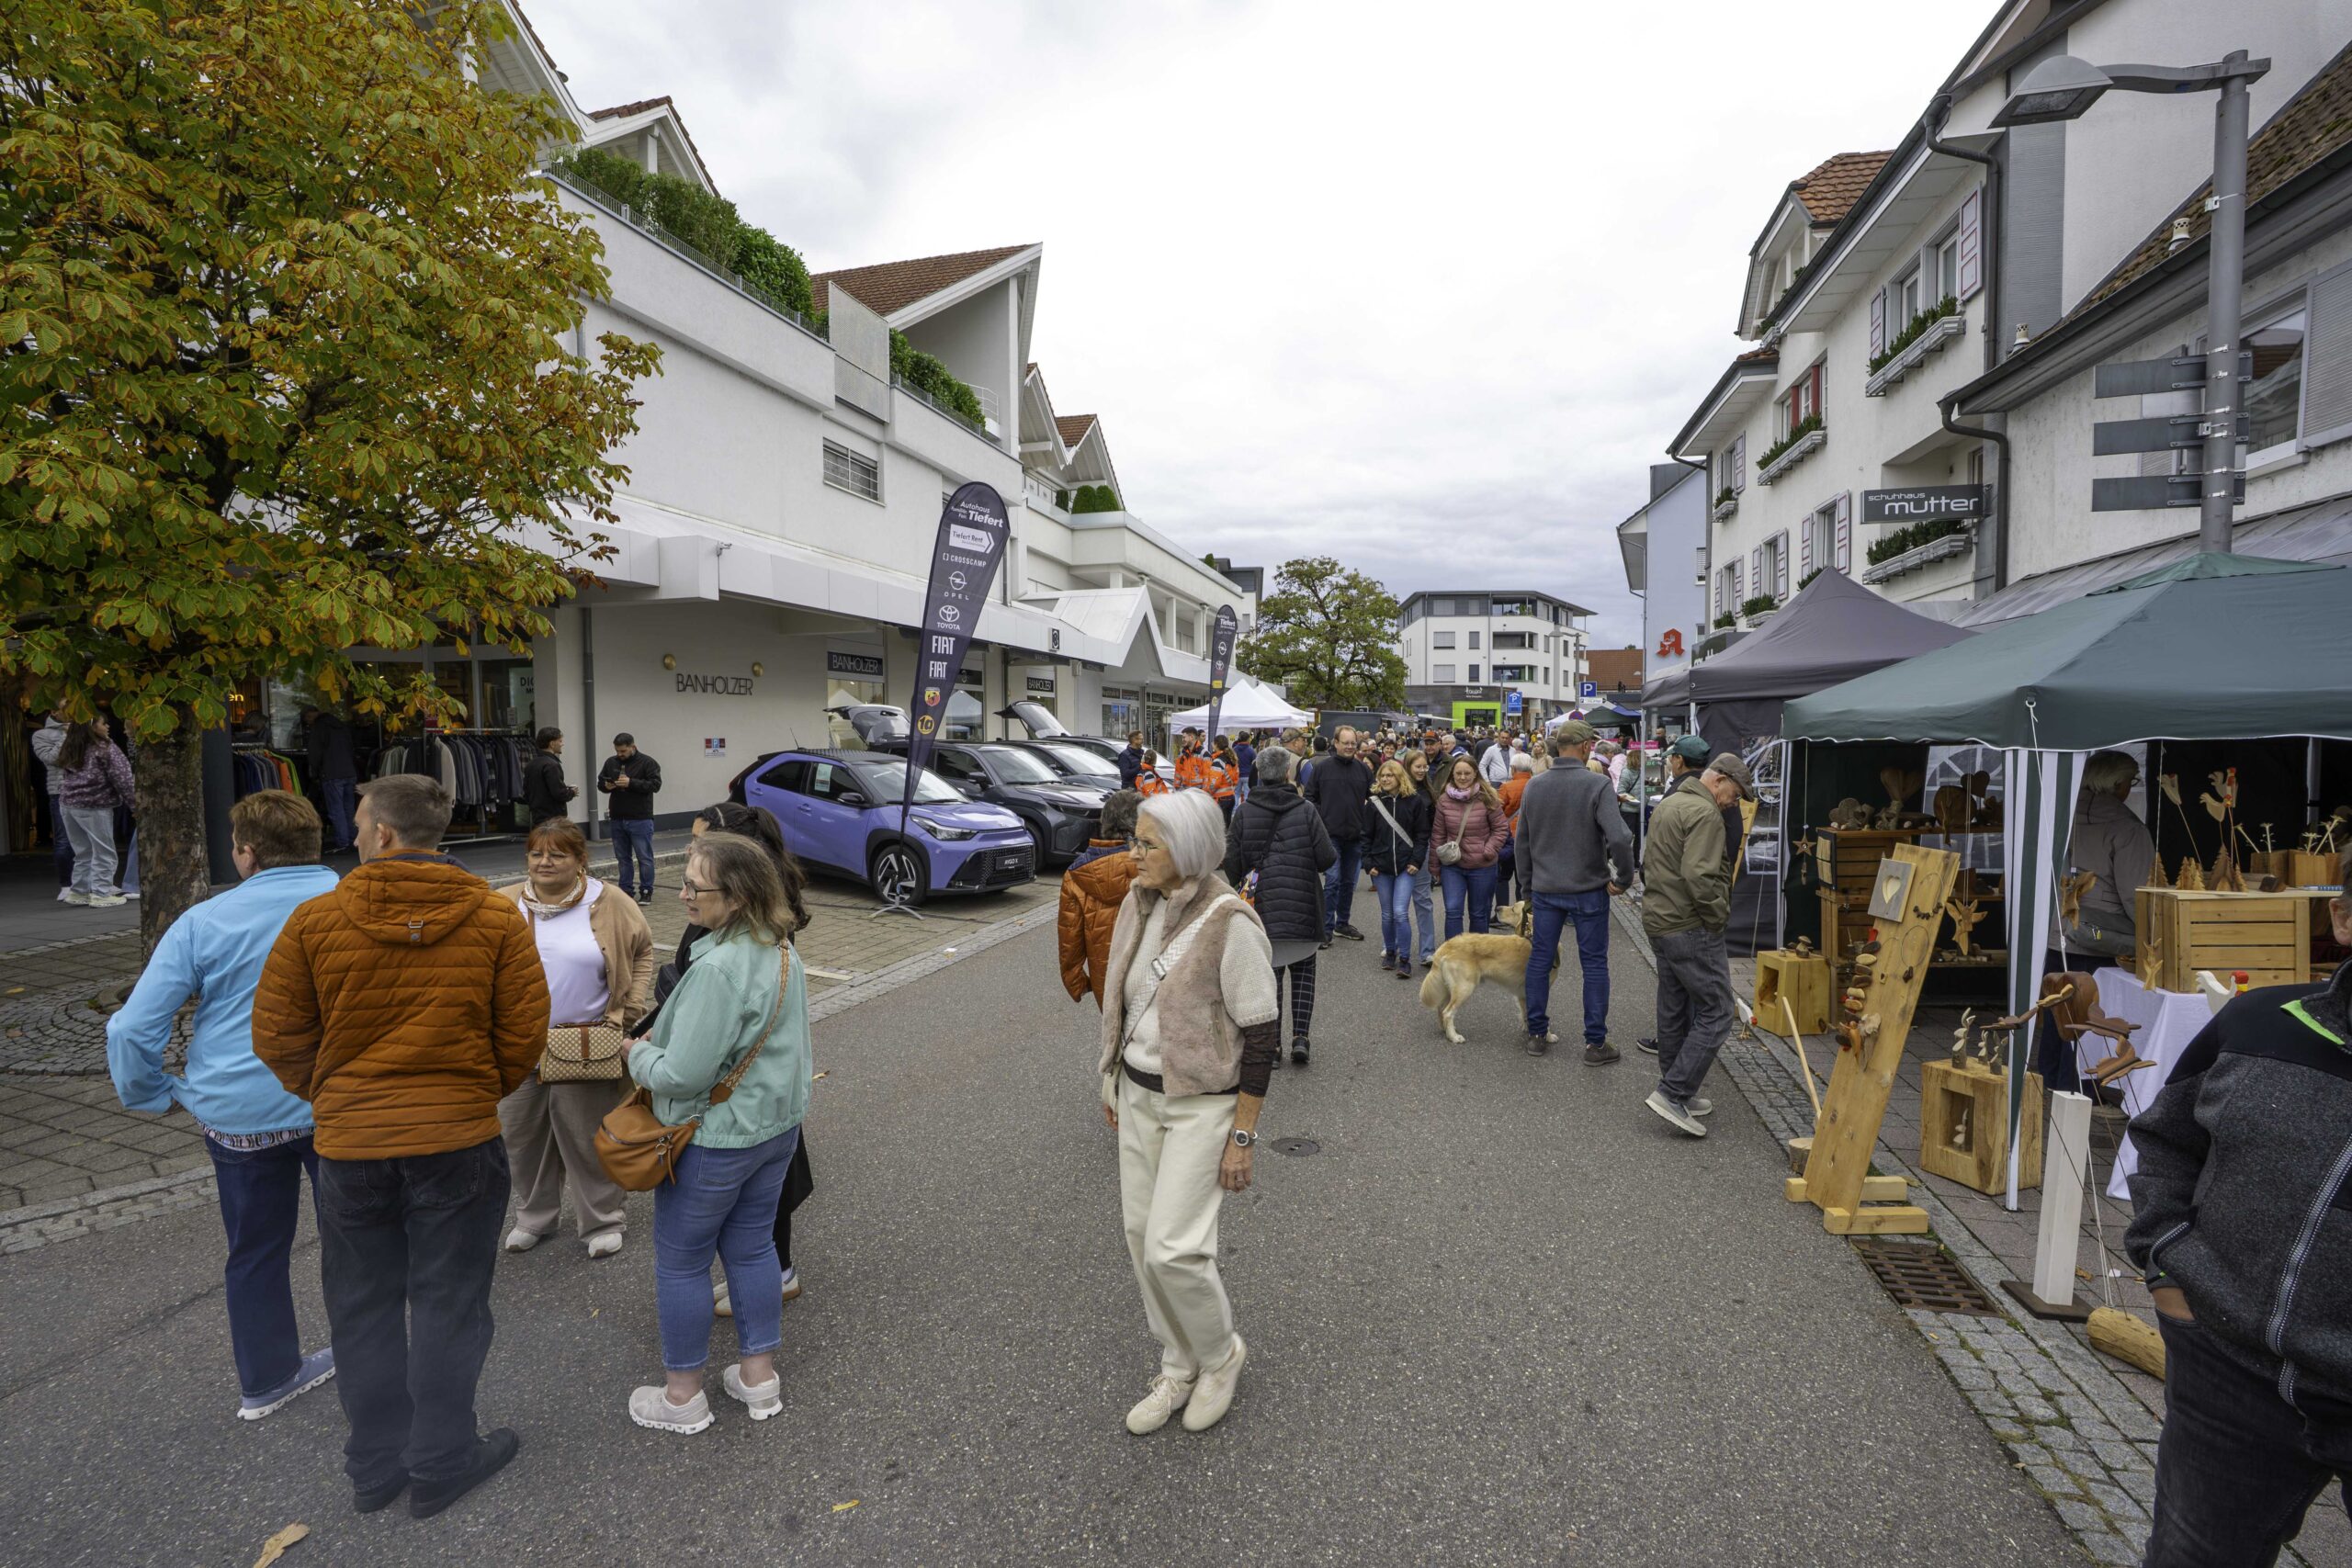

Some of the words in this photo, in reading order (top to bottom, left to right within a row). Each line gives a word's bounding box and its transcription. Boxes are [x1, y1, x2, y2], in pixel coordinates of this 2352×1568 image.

[1868, 492, 1926, 502] schuhhaus
[960, 502, 990, 513] Autohaus
[1884, 496, 1979, 514] mutter
[968, 510, 1003, 528] Tiefert
[953, 531, 971, 540] Tiefert
[971, 535, 983, 543] Rent
[950, 555, 987, 568] CROSSCAMP
[944, 591, 969, 601] OPEL
[937, 622, 961, 630] TOYOTA
[932, 635, 956, 655] FIAT
[832, 654, 879, 672] BANHOLZER
[929, 660, 947, 678] FIAT
[676, 672, 753, 696] BANHOLZER
[1584, 683, 1593, 696] P
